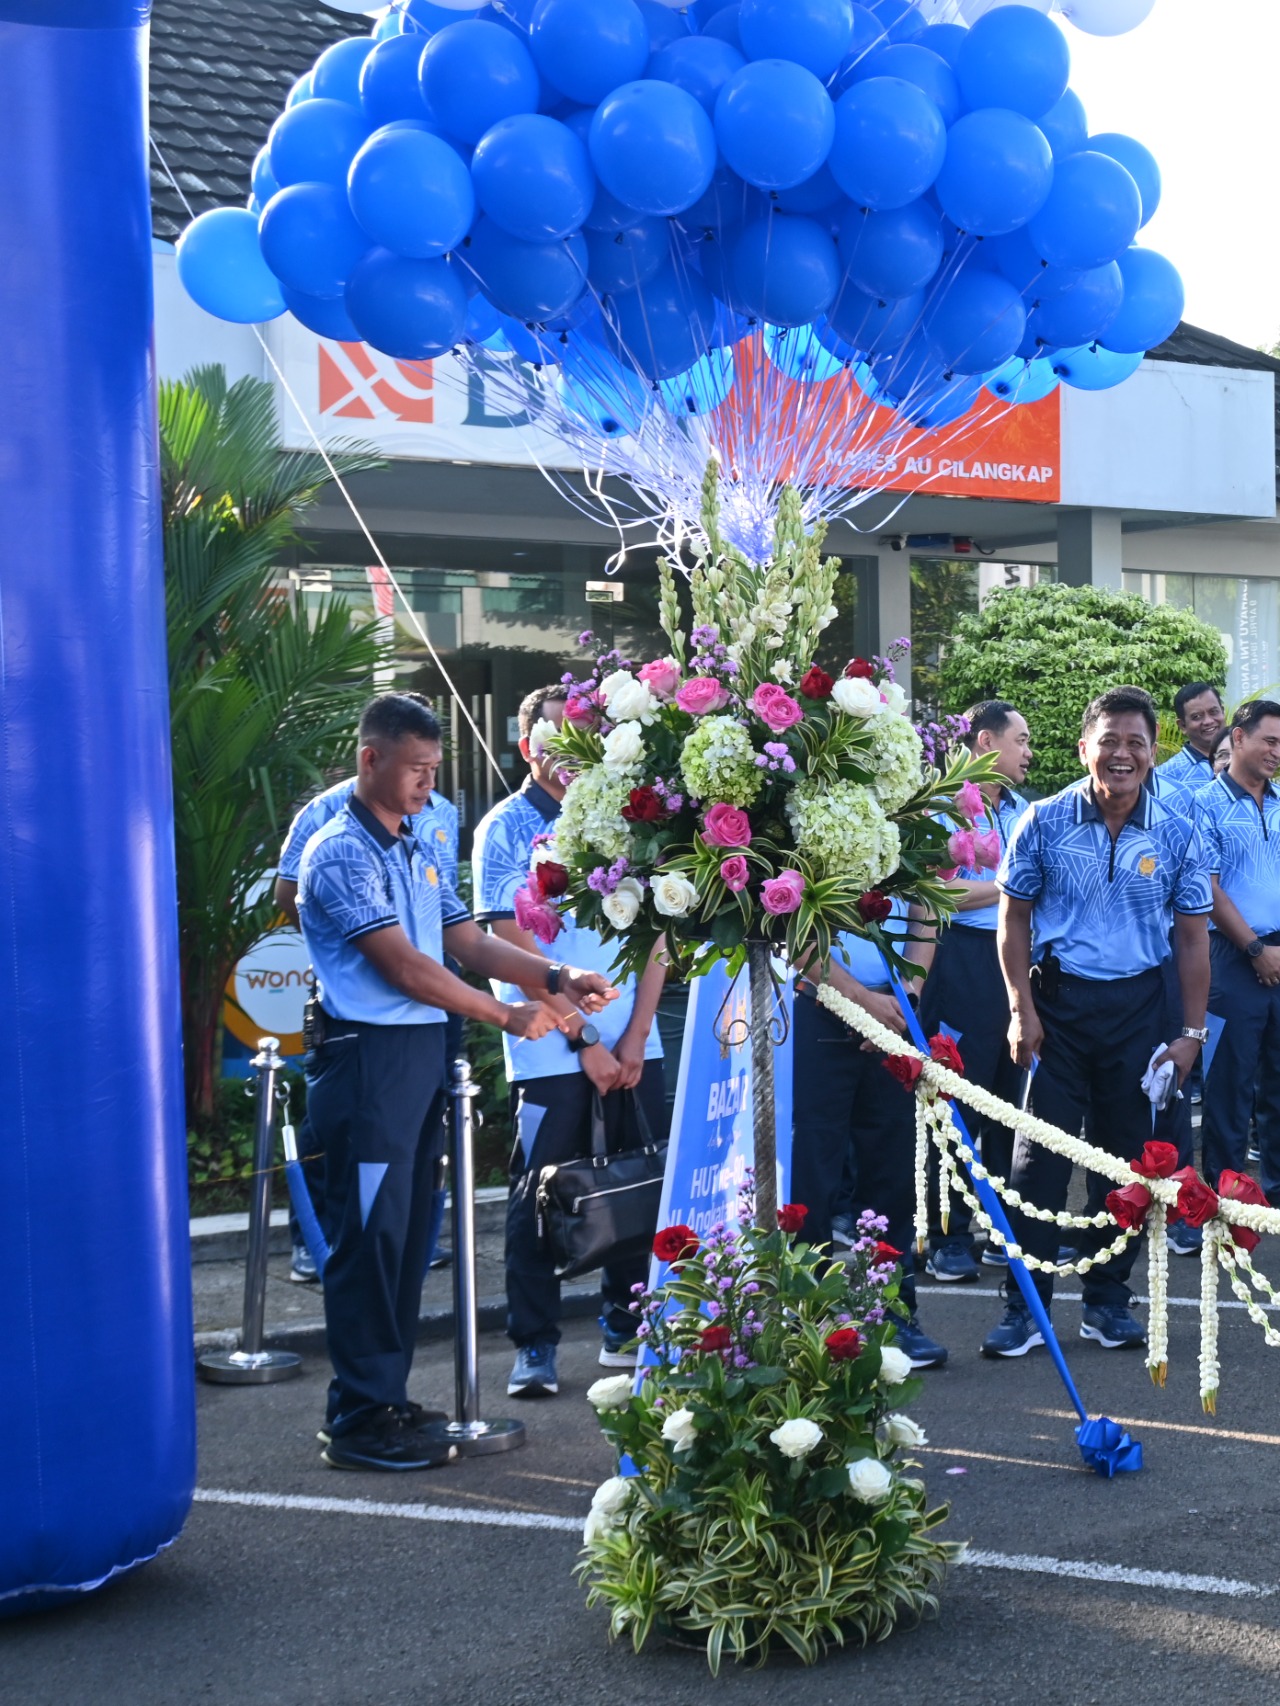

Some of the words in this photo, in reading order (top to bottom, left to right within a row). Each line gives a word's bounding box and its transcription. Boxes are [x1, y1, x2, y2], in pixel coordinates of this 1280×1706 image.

[904, 456, 932, 474] AU
[938, 459, 1053, 483] CILANGKAP
[706, 1074, 750, 1121] BAZAR
[690, 1163, 719, 1199] HUT
